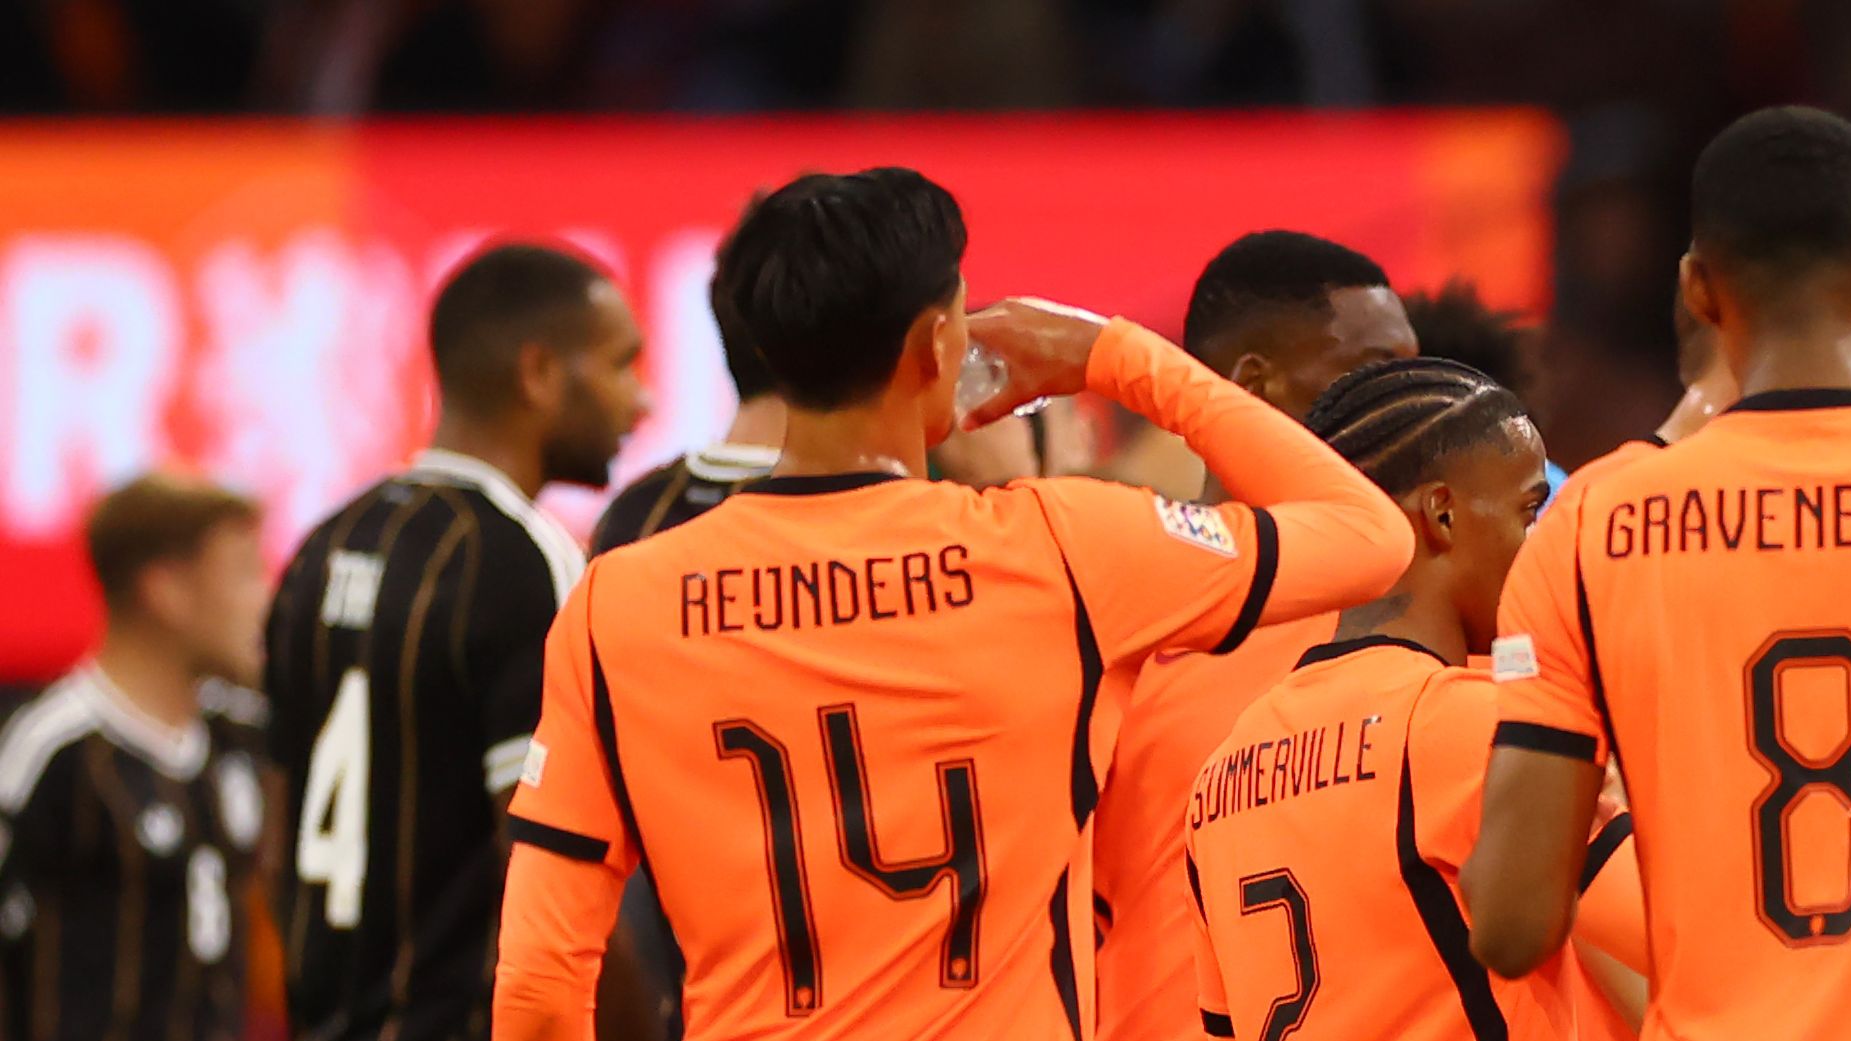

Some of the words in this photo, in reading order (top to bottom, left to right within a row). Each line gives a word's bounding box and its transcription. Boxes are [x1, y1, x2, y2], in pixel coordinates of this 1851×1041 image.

[681, 545, 974, 637] REIJNDERS
[296, 667, 370, 929] 4
[712, 703, 987, 1018] 14
[1191, 716, 1381, 831] SUMMERVILLE
